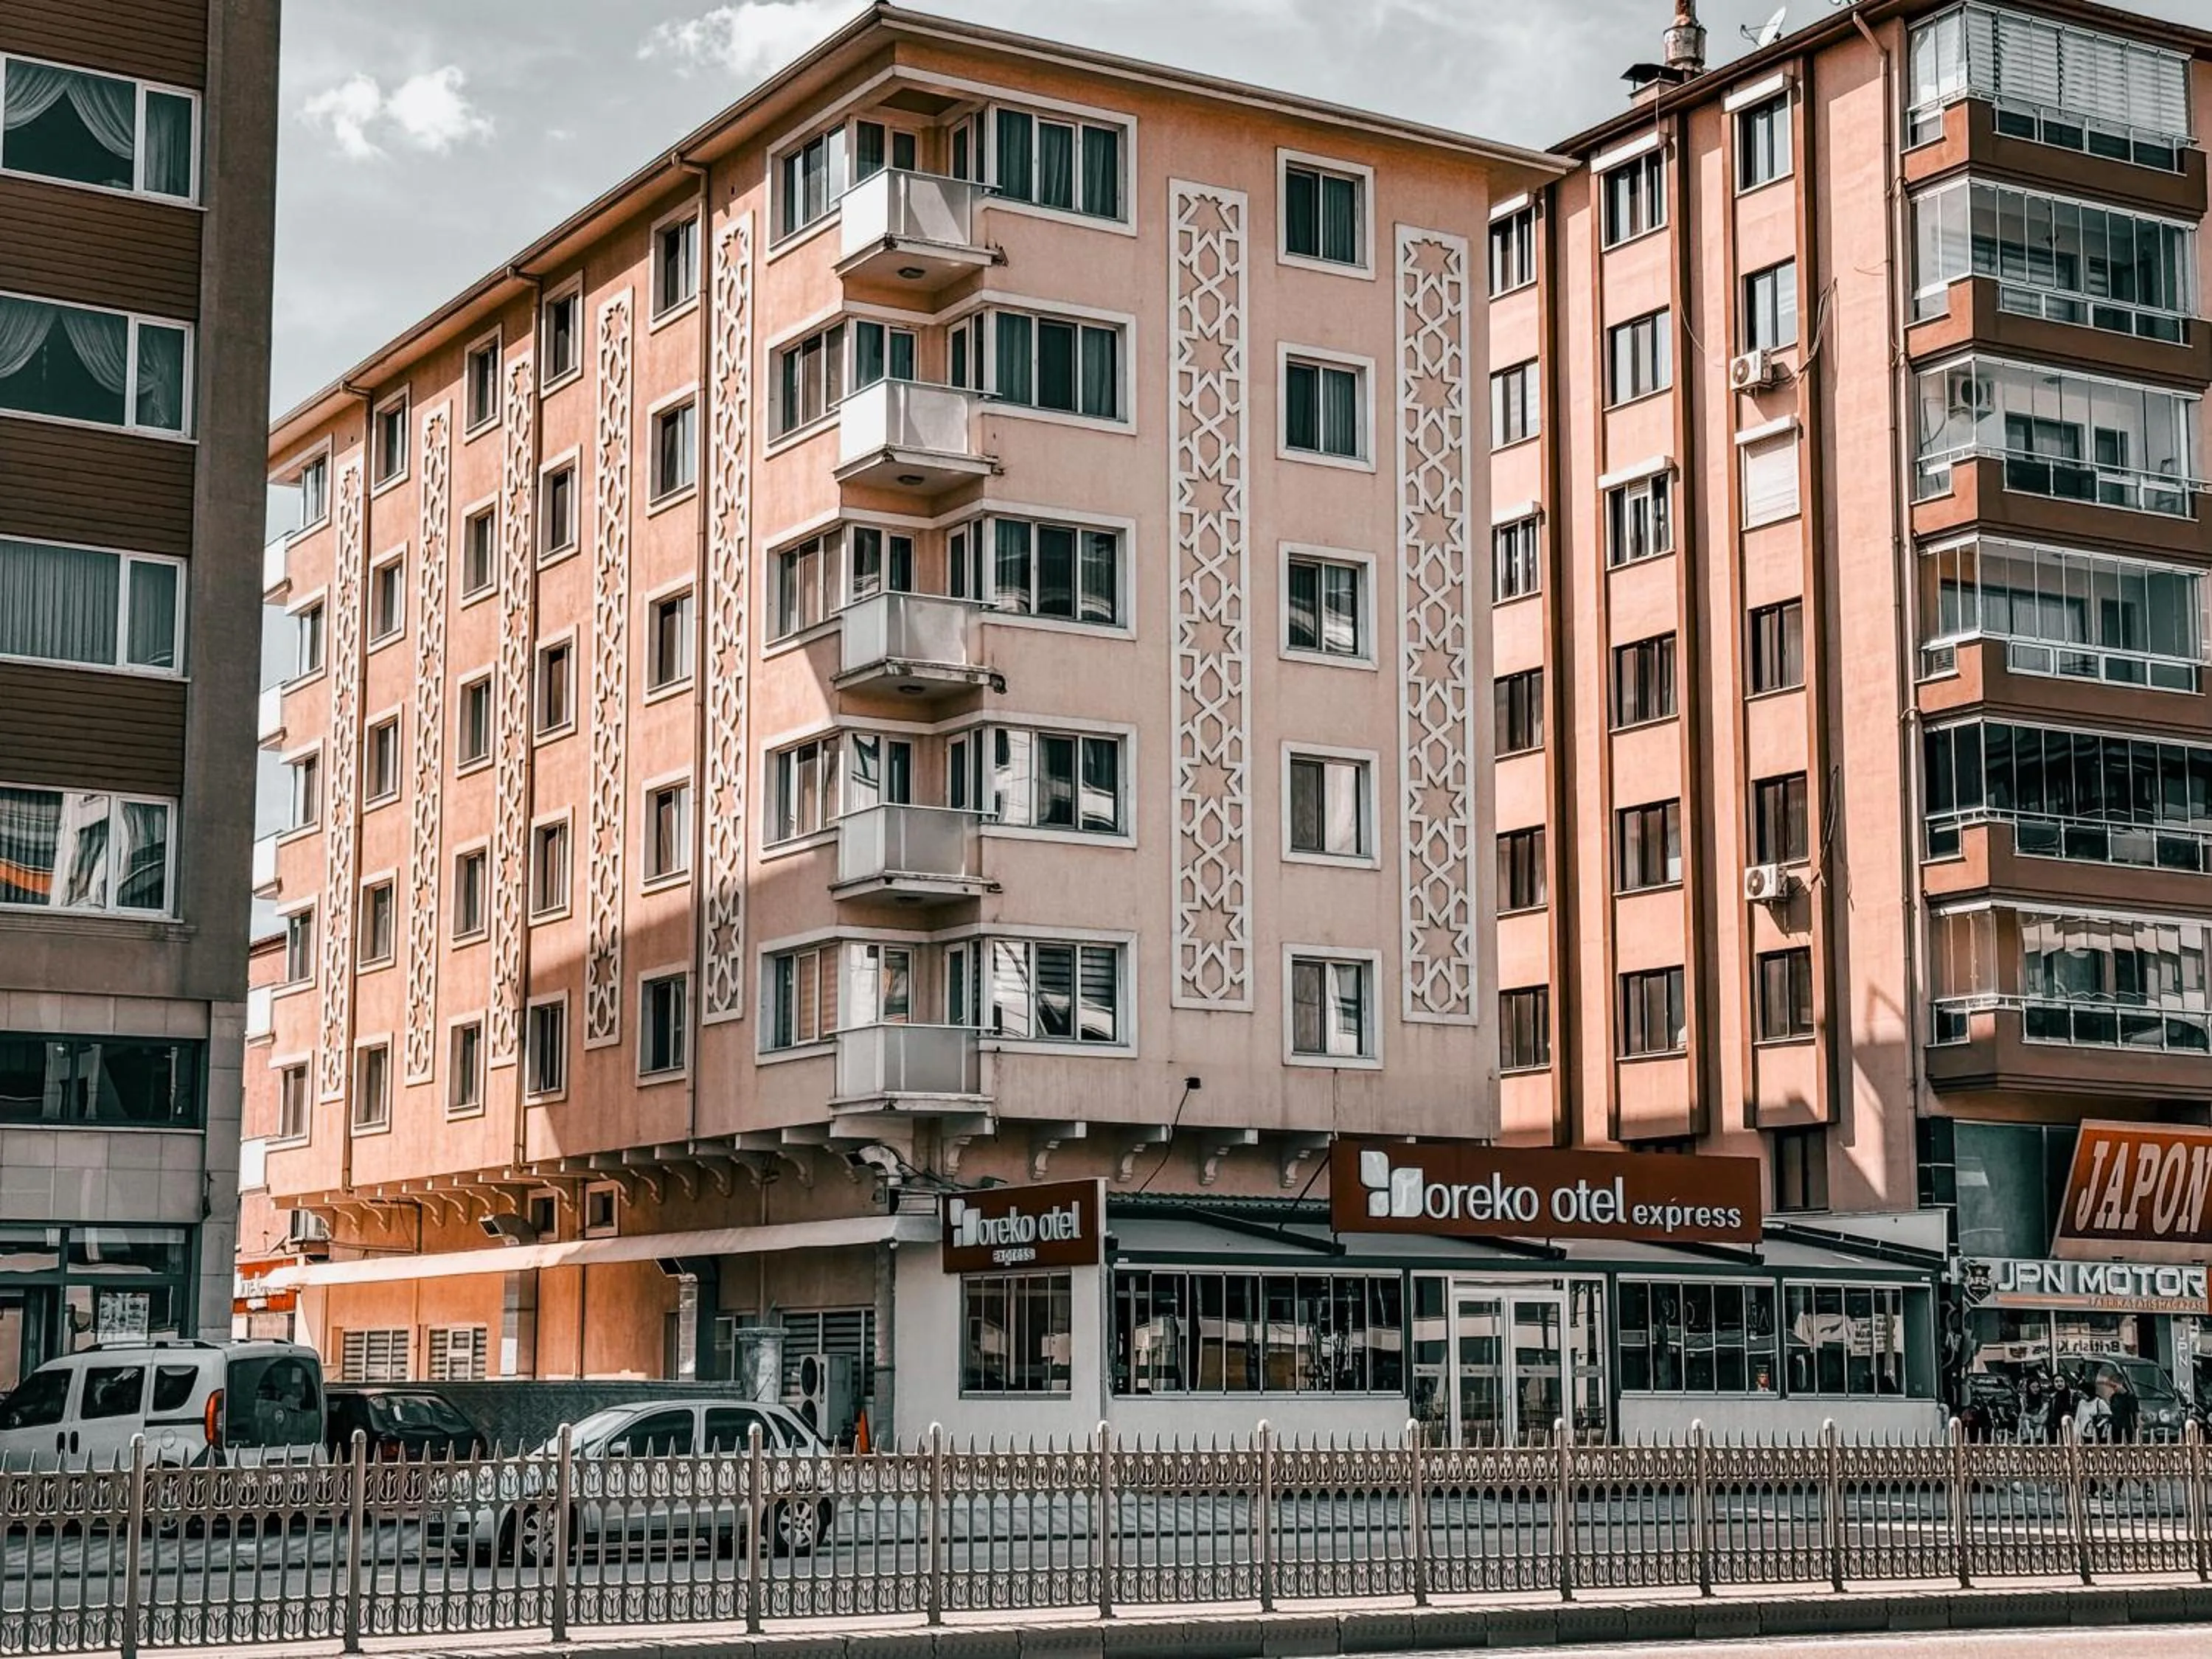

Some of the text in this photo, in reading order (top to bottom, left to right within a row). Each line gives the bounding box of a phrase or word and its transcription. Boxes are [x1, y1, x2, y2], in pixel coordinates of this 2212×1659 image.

[978, 1200, 1082, 1246] oreko otel
[1423, 1171, 1742, 1233] oreko otel express
[1997, 1262, 2208, 1298] JPN MOTOR
